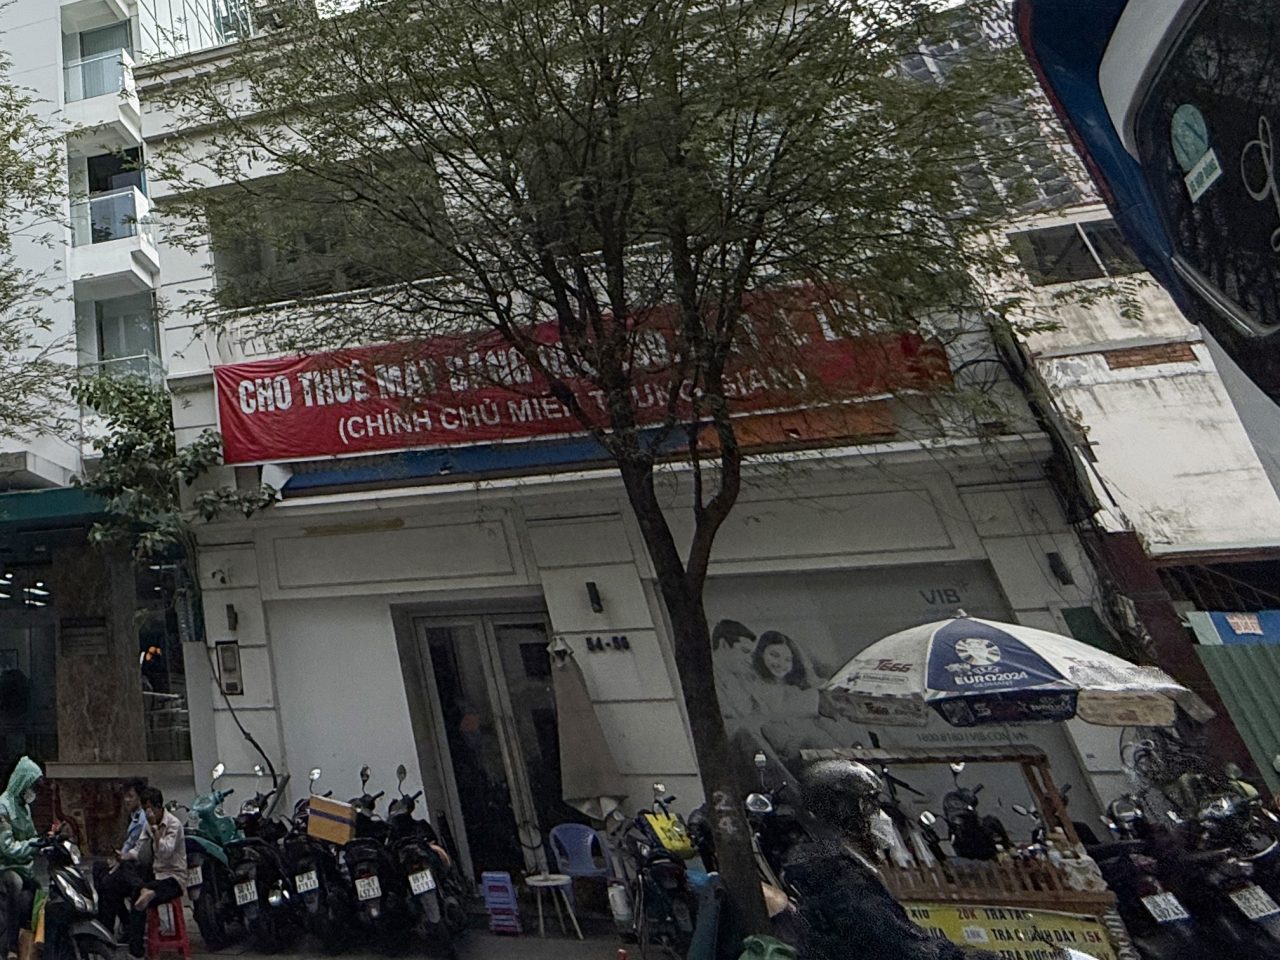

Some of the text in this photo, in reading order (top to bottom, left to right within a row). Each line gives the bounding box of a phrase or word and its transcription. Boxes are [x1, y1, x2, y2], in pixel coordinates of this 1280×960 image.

[238, 375, 292, 414] CHO
[297, 360, 370, 407] THUÊ
[339, 408, 432, 444] (CHÍNH
[440, 398, 500, 430] CHỦ
[919, 589, 961, 604] VIB
